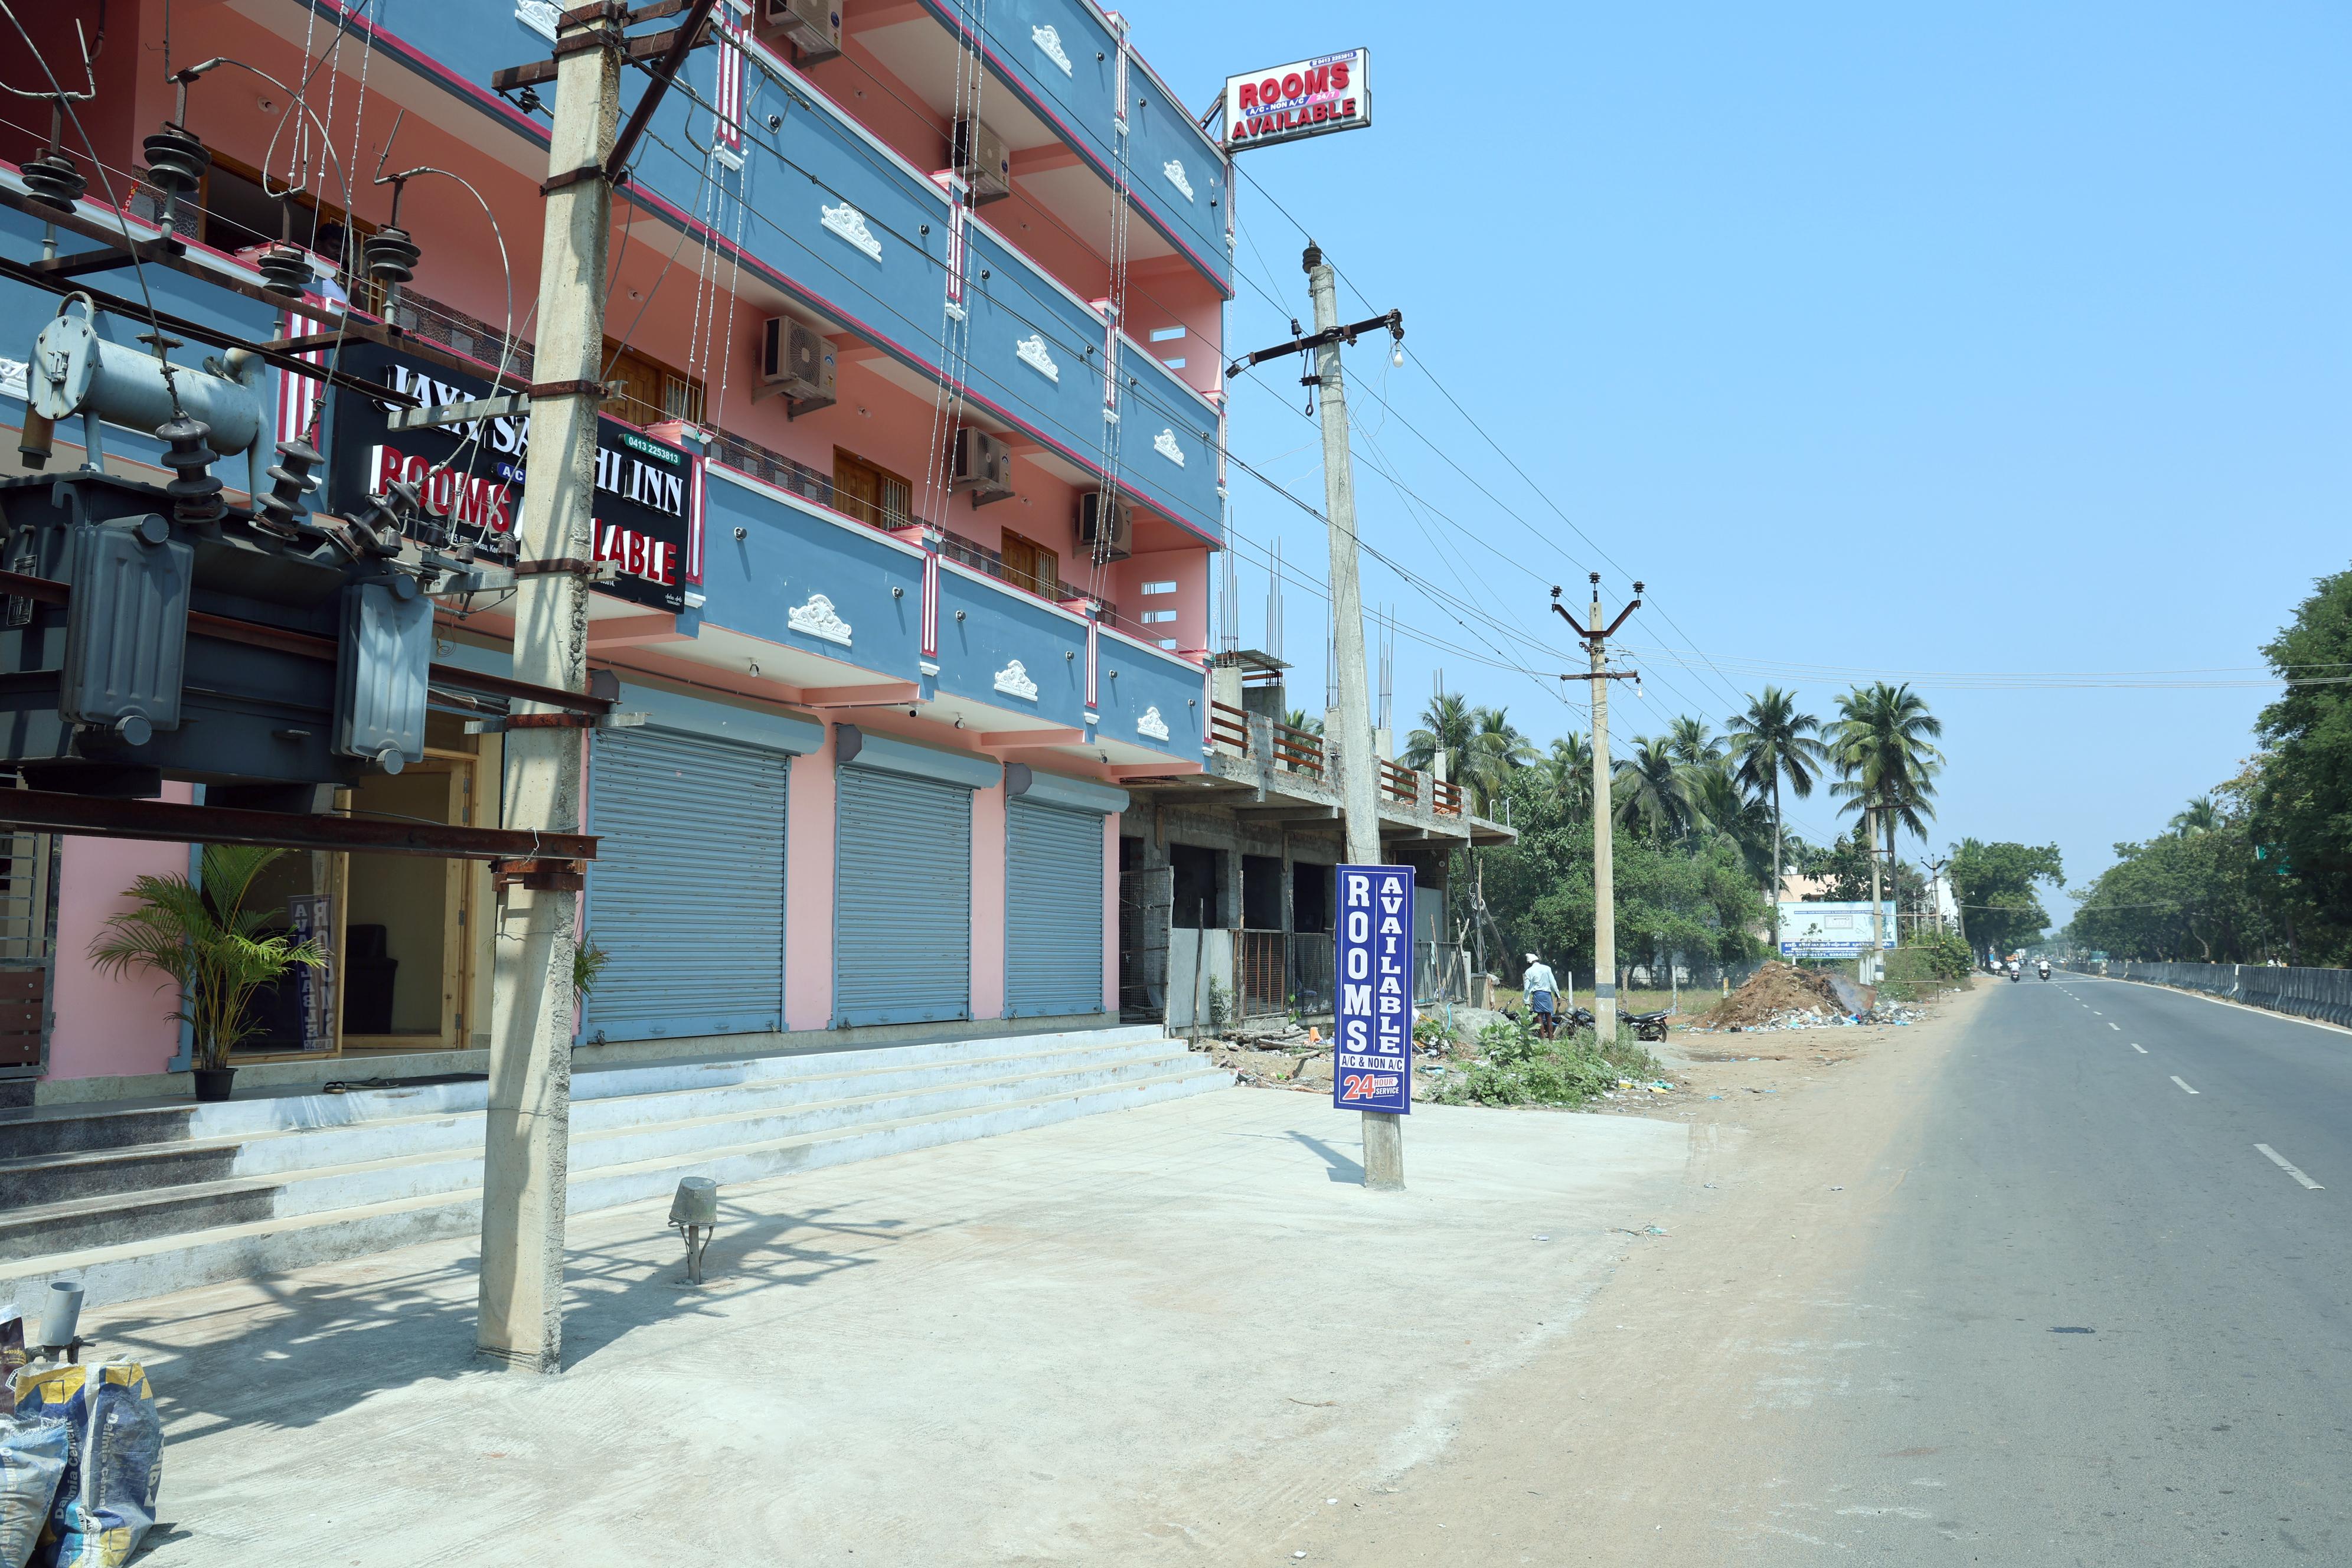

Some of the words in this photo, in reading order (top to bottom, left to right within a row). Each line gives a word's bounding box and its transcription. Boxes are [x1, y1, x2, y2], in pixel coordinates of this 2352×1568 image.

[1240, 62, 1350, 109] ROOMS
[1249, 105, 1265, 115] A/C
[1270, 101, 1288, 111] NON
[1289, 97, 1305, 106] A/C
[1316, 91, 1335, 101] 24/7
[1231, 97, 1356, 139] AVAILABLE
[629, 436, 647, 450] 0413
[648, 445, 678, 463] 2253813
[370, 444, 512, 534] ROOMS
[626, 459, 683, 517] INN
[1344, 875, 1371, 1053] ROOMS
[1379, 877, 1403, 1054] AVAILABLE
[1342, 1056, 1355, 1067] A/C
[1358, 1056, 1364, 1067] &
[1368, 1057, 1385, 1069] NON
[1388, 1059, 1402, 1071] A/C
[1342, 1074, 1375, 1100] 24
[1374, 1078, 1393, 1087] HOUR
[1376, 1086, 1399, 1095] SERVICE
[101, 1412, 119, 1463] Dalmia
[54, 1471, 79, 1520] Dalmia
[99, 1466, 109, 1507] Ceme
